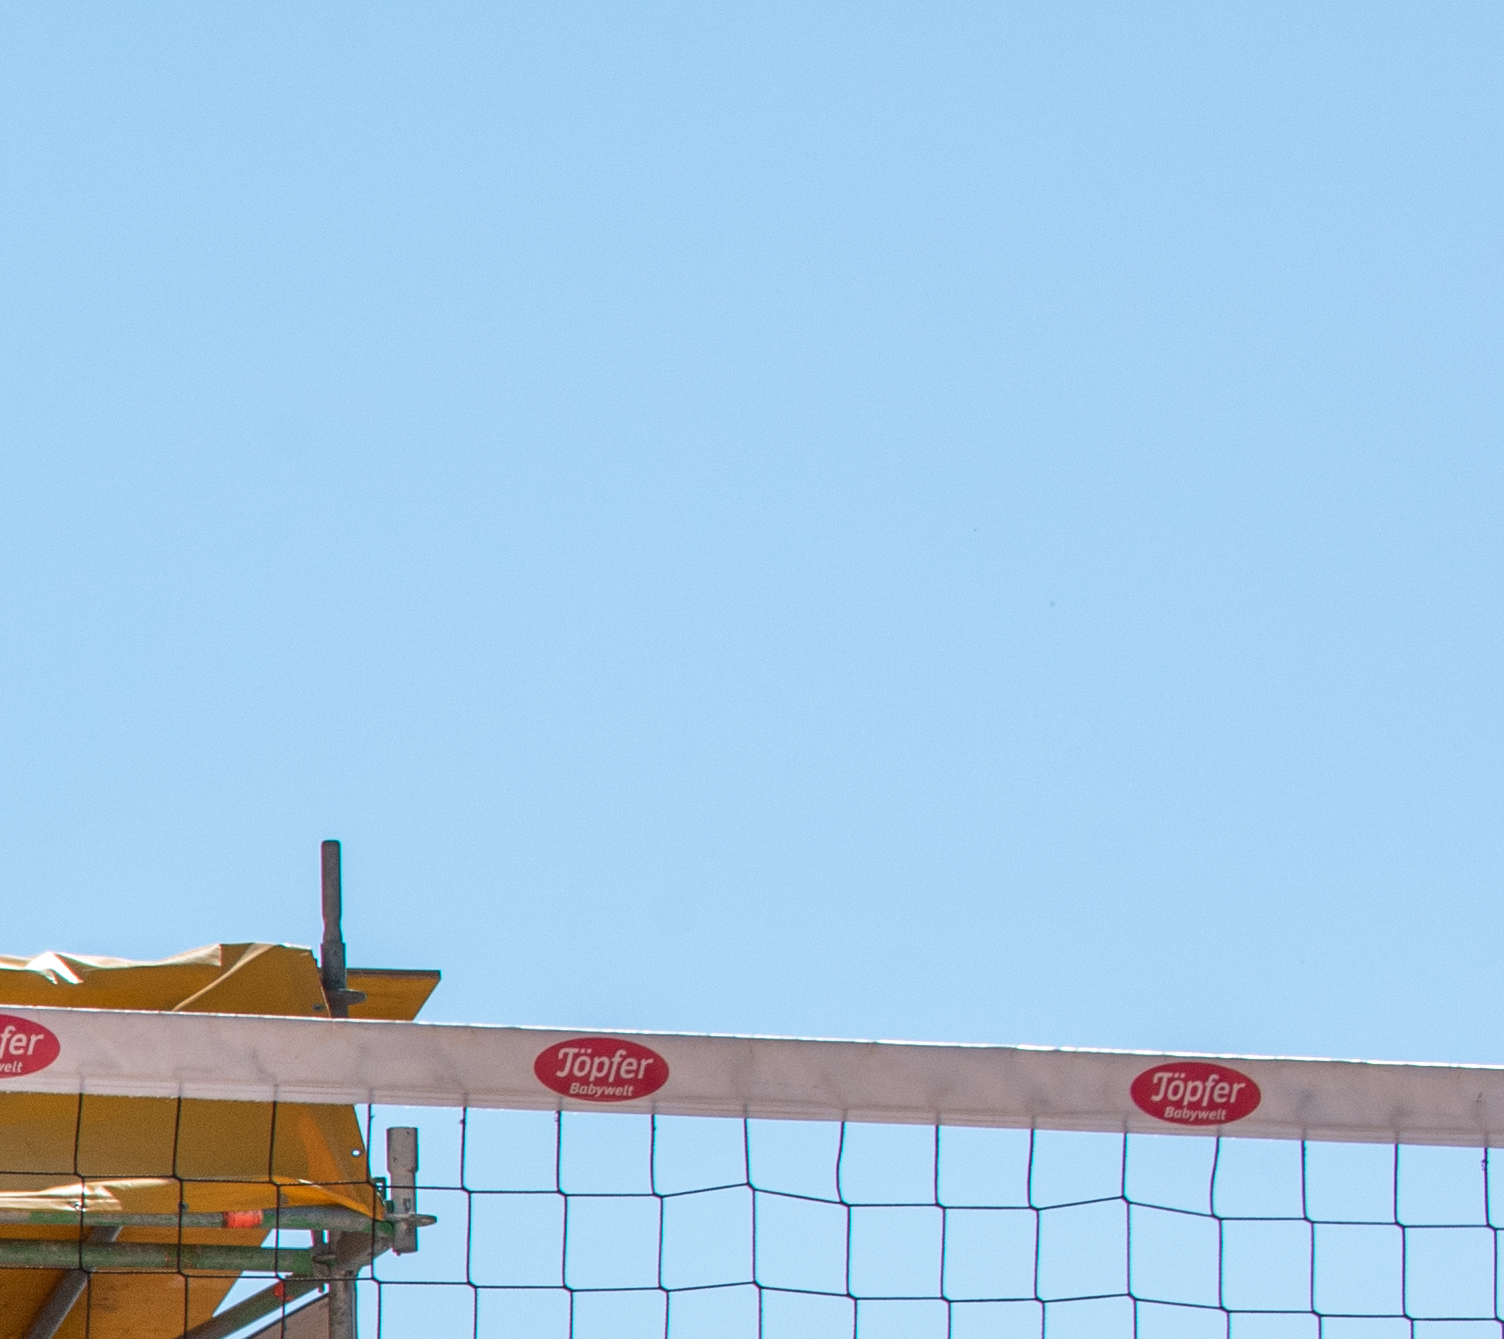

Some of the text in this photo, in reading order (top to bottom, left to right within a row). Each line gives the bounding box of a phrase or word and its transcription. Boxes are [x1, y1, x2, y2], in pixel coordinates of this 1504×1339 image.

[555, 1047, 654, 1083] Töpfer
[569, 1083, 634, 1098] Babywelt
[1150, 1071, 1246, 1107] Töpfer
[1163, 1106, 1227, 1122] Babywelt
